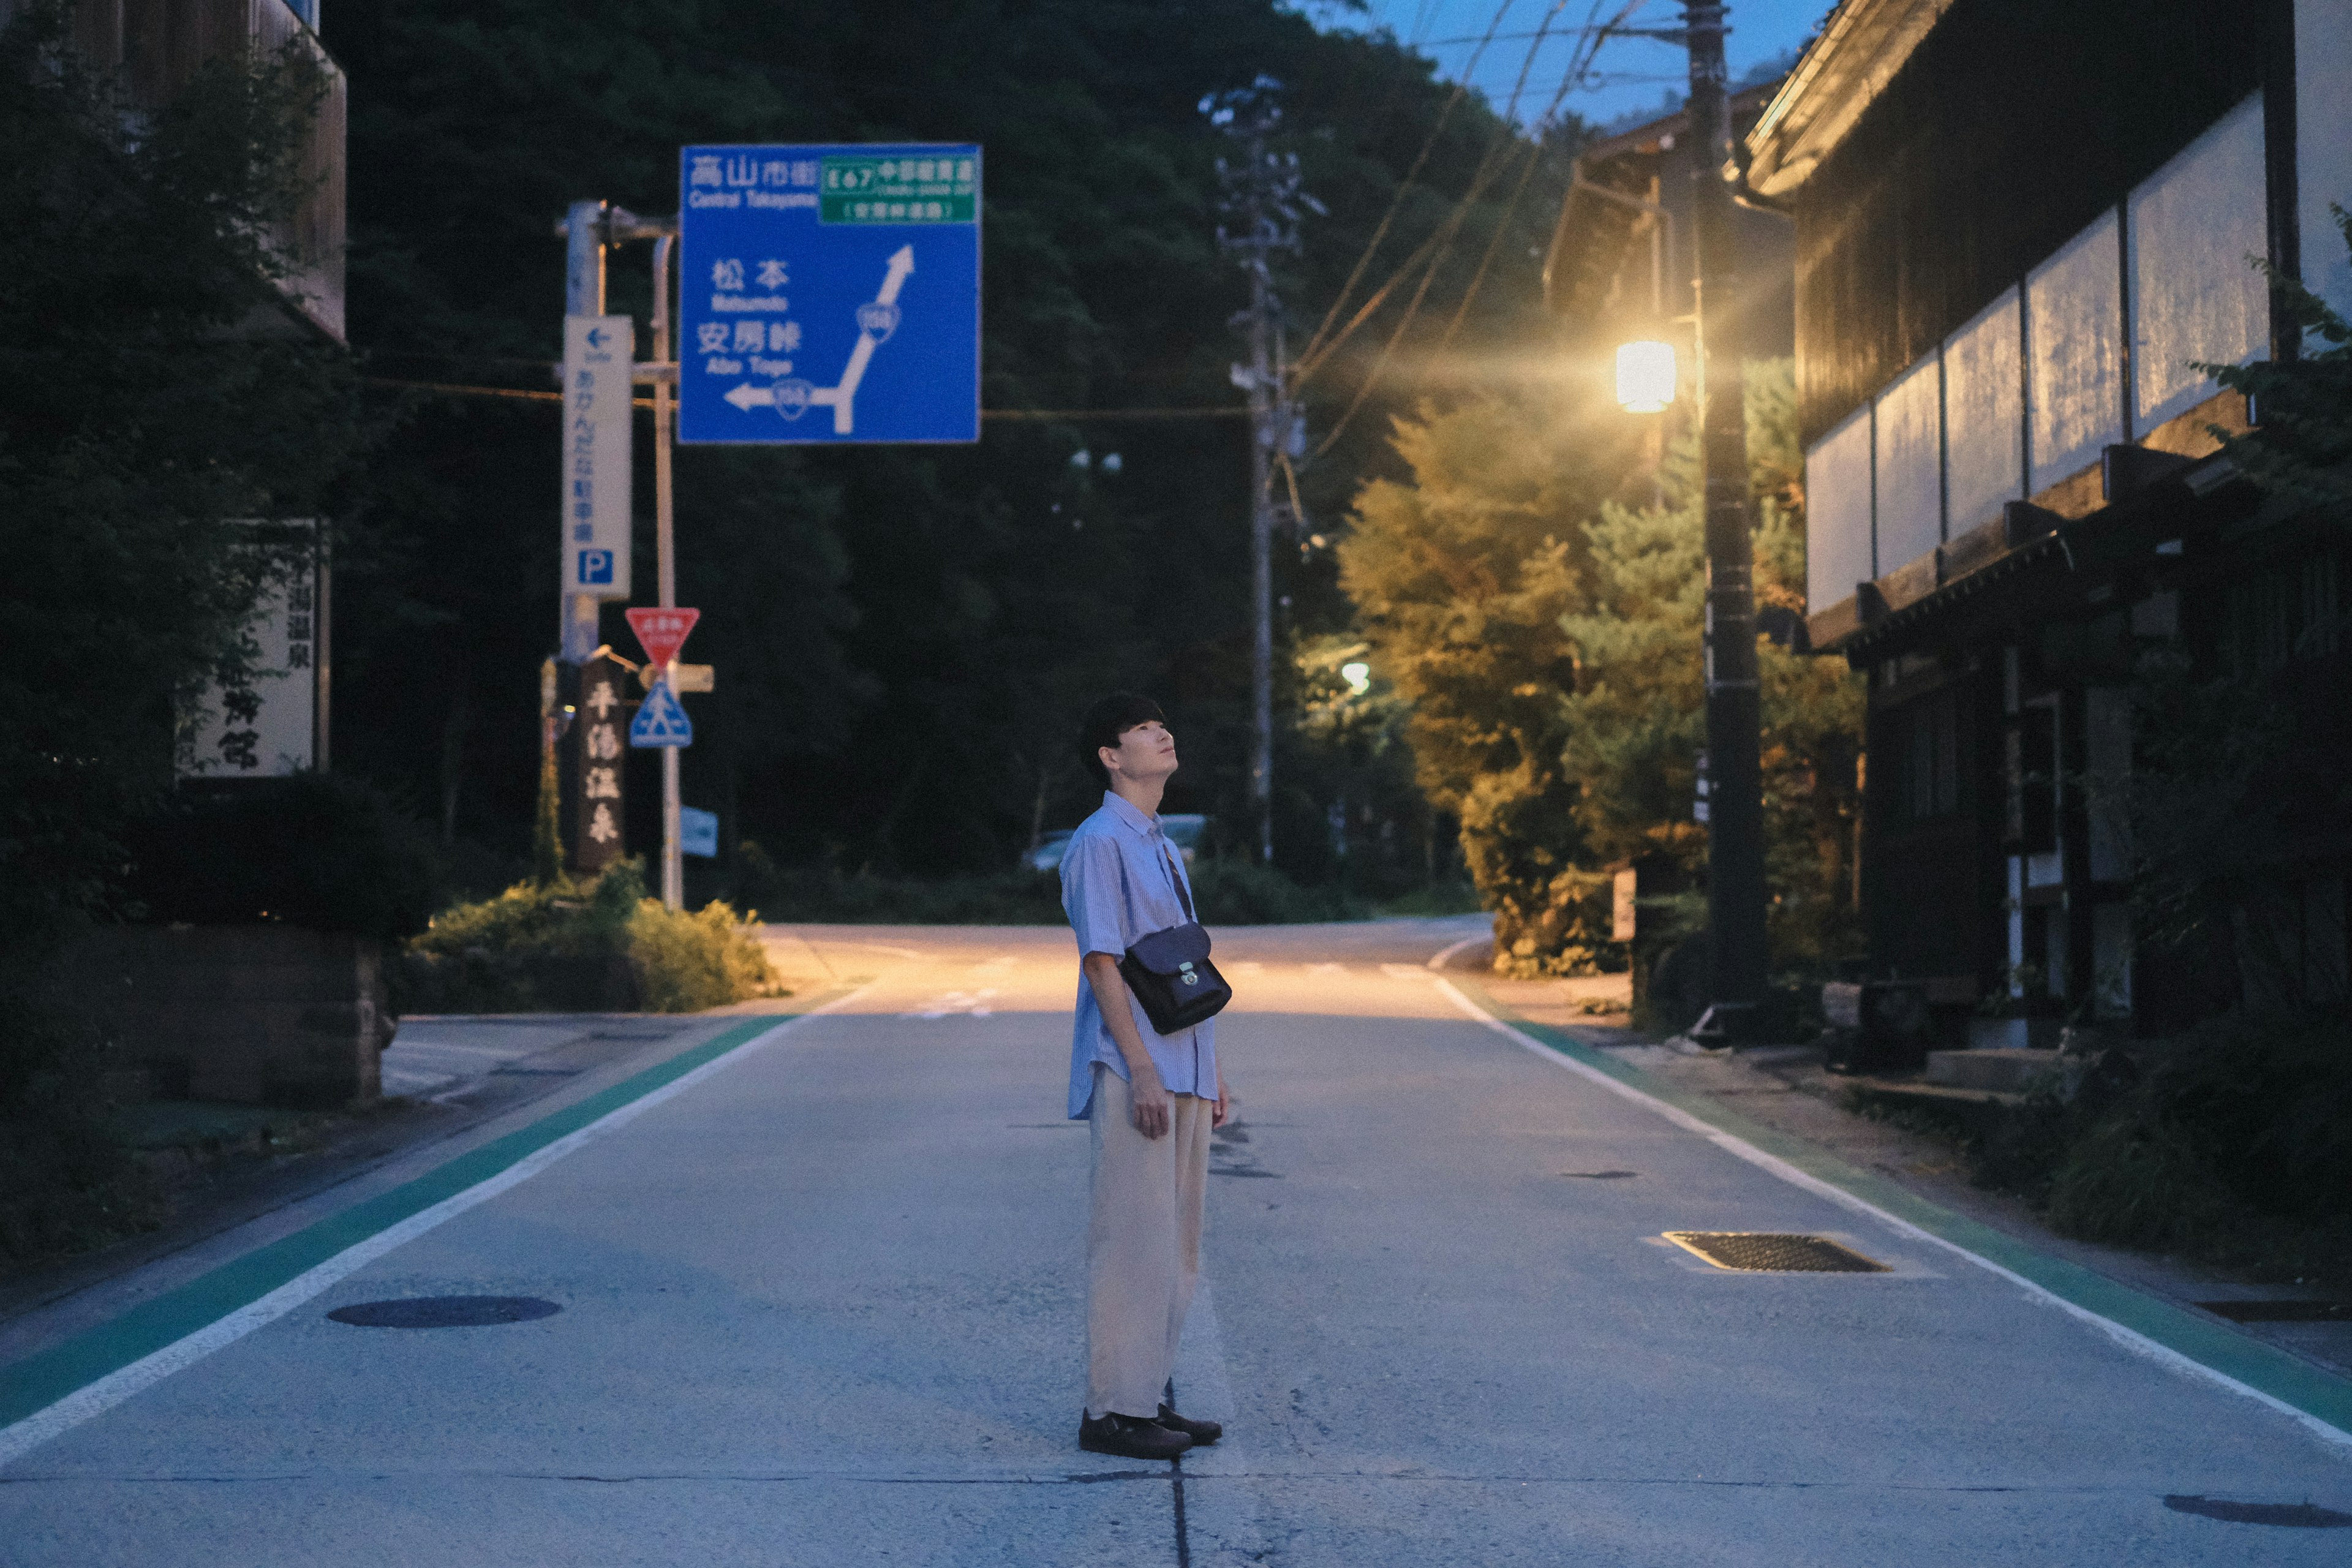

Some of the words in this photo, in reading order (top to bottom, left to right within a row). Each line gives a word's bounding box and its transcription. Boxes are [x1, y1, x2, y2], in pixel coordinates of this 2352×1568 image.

[691, 156, 817, 187] 高山市街
[828, 168, 872, 189] E67
[711, 258, 790, 292] 松本
[697, 320, 802, 354] 安房峠
[585, 550, 606, 582] P
